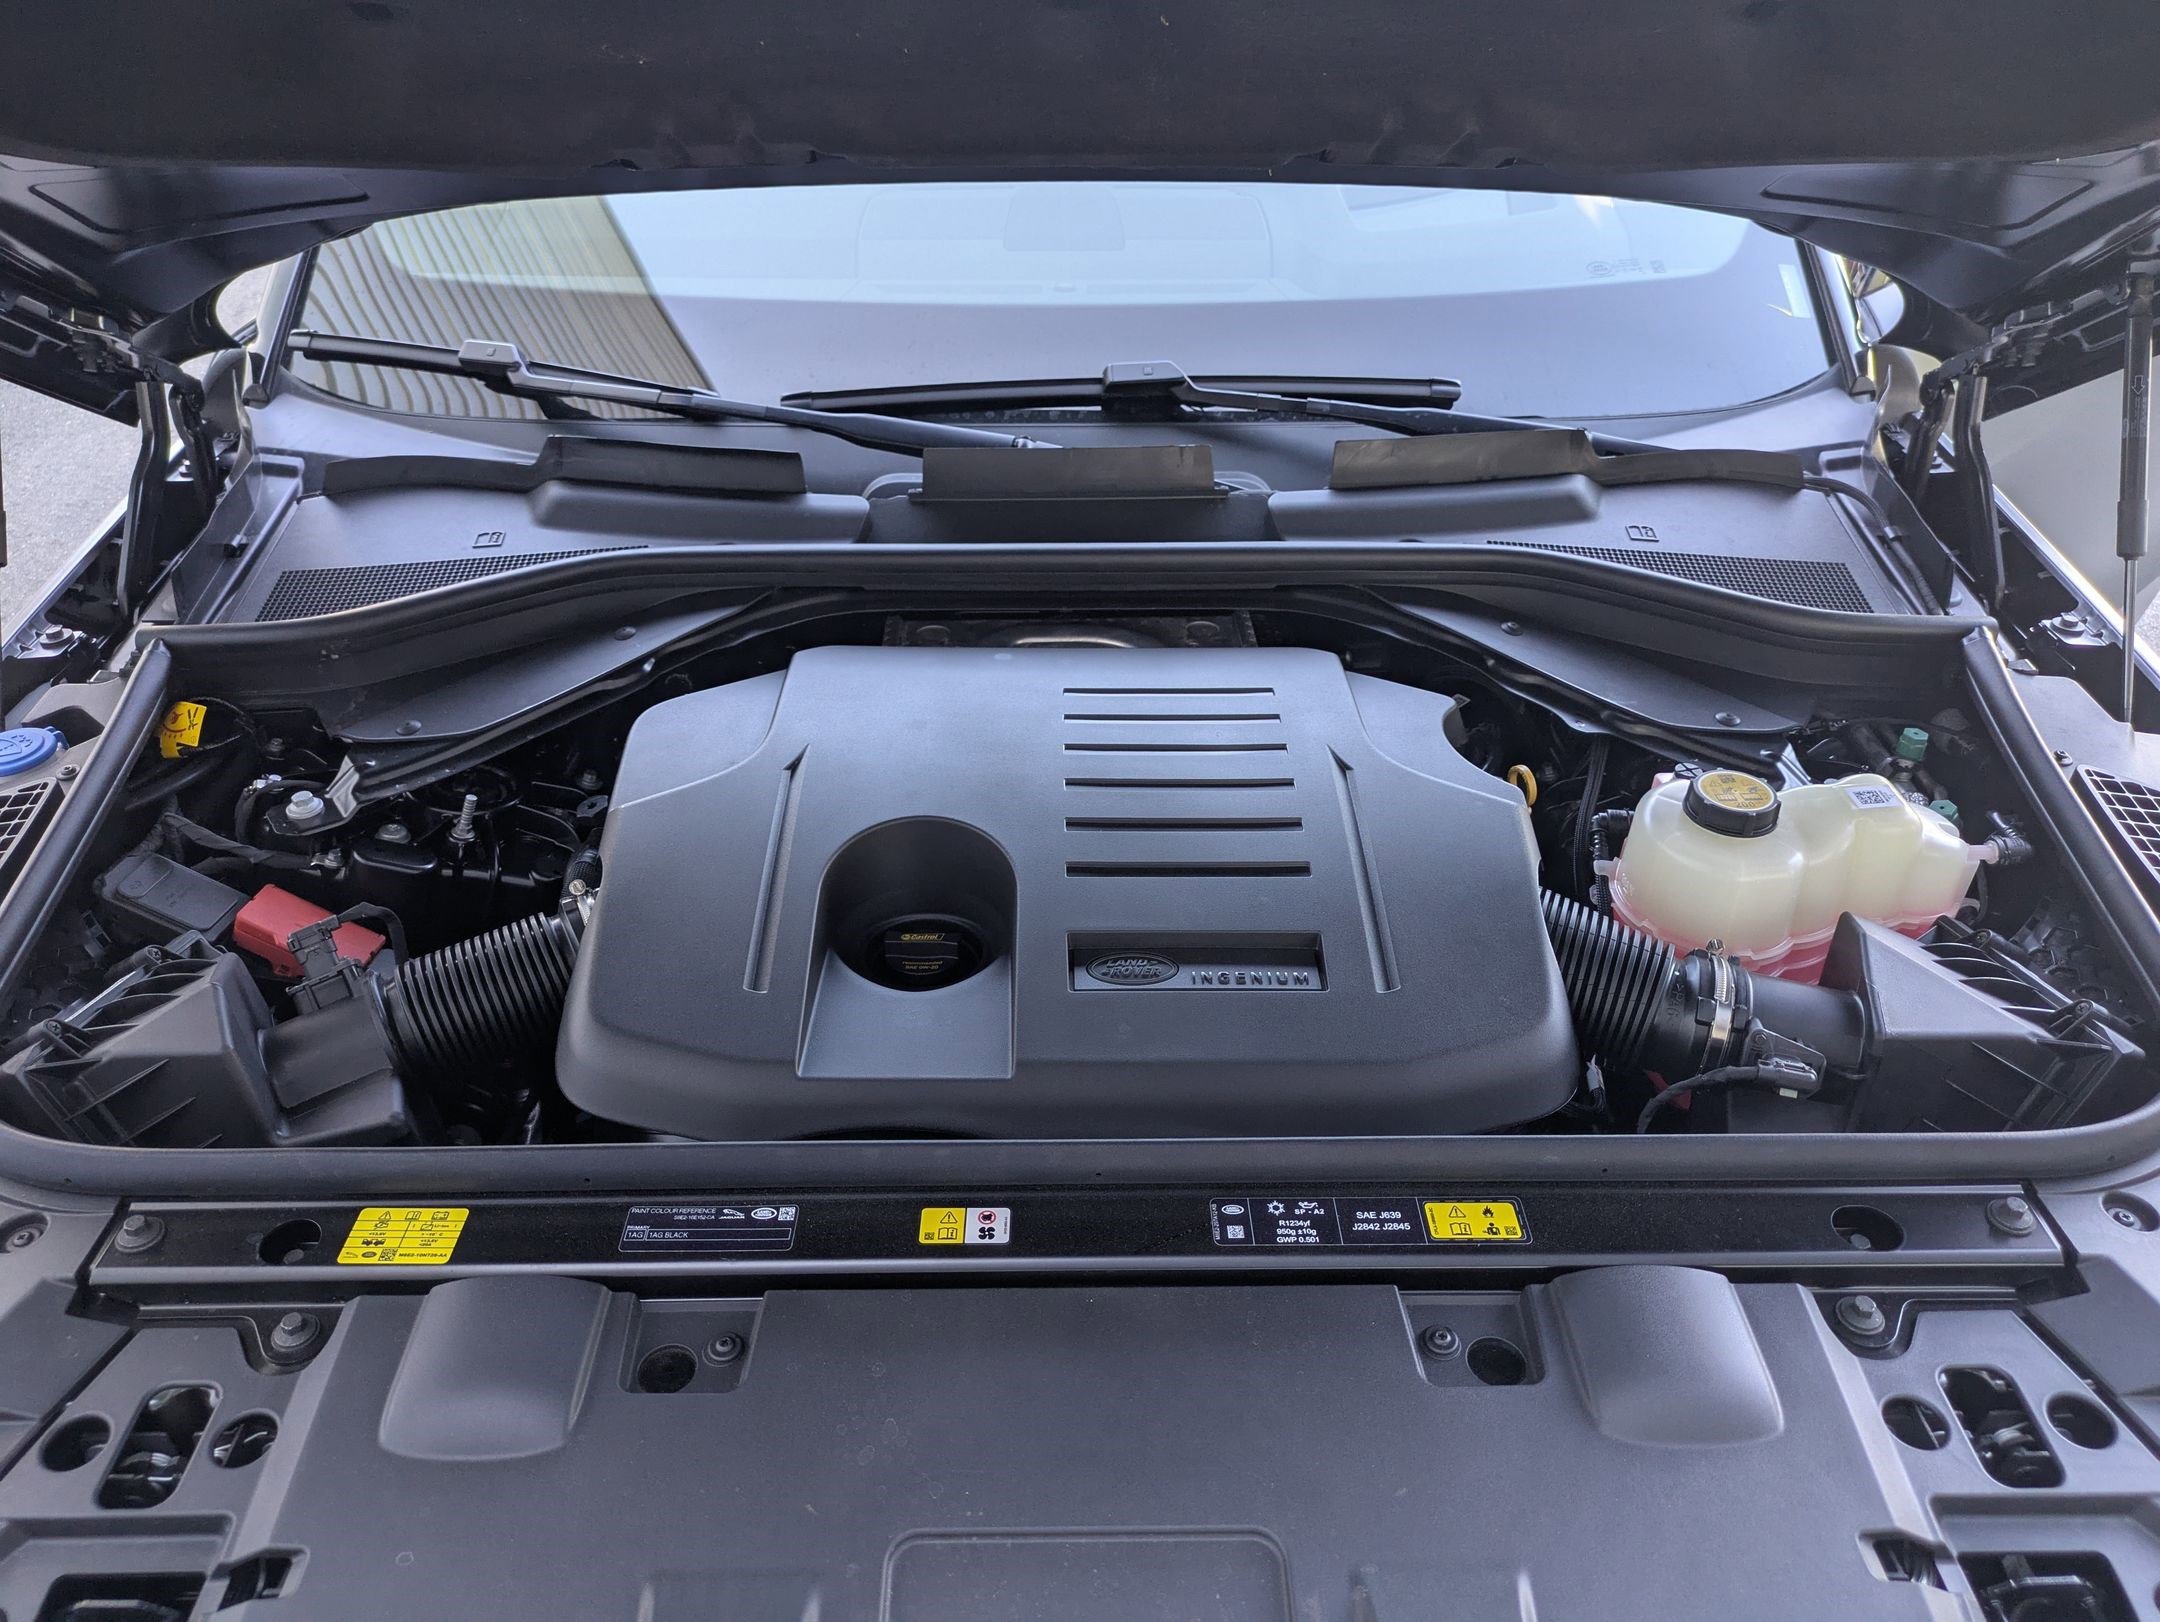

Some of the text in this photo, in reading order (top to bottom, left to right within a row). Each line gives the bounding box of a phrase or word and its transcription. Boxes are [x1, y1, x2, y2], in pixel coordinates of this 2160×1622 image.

[1106, 958, 1149, 967] LAND
[1108, 966, 1162, 979] ROVER
[1191, 970, 1310, 986] INGENIUM
[1356, 1211, 1402, 1219] SAE J639
[1352, 1222, 1411, 1231] J2842 J2845
[628, 1231, 644, 1239] 1AG
